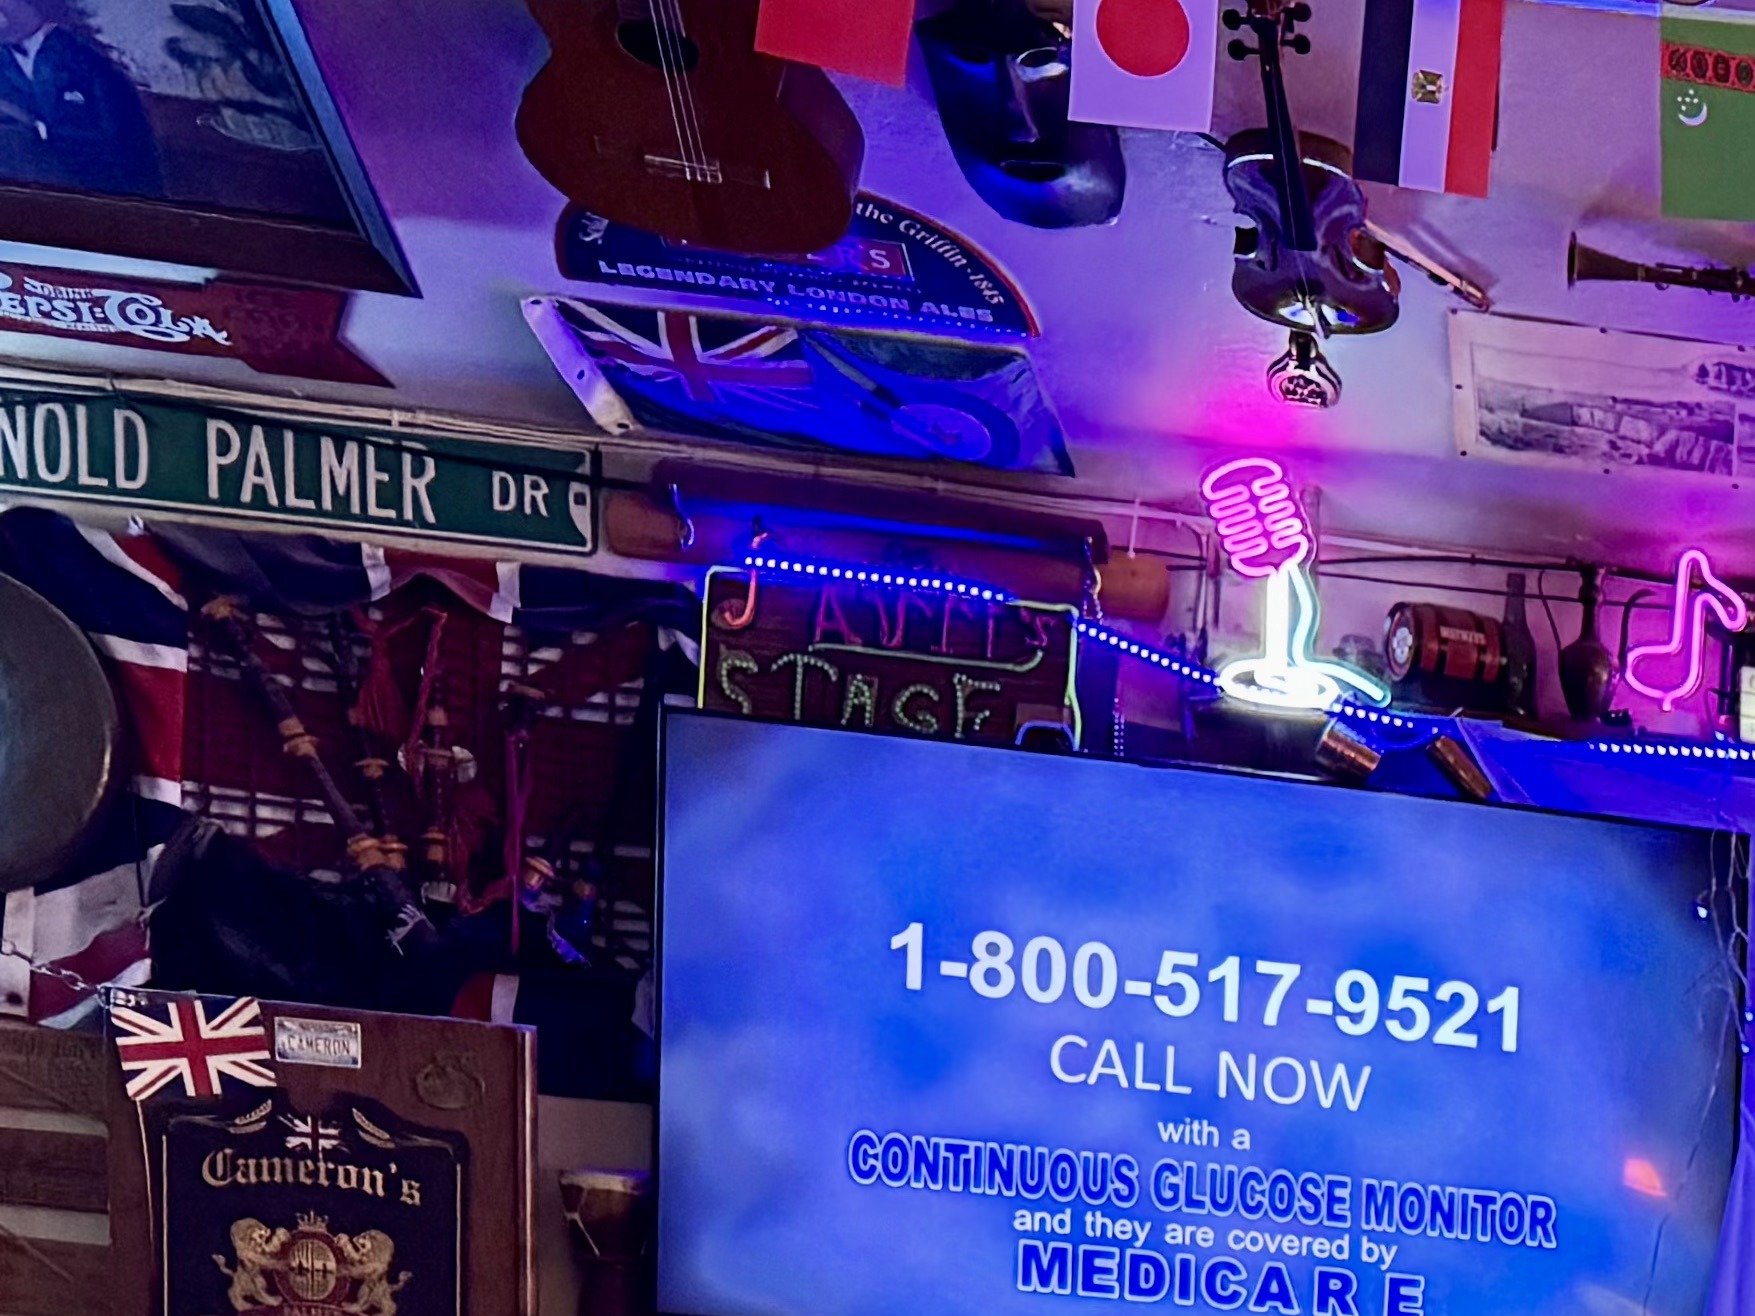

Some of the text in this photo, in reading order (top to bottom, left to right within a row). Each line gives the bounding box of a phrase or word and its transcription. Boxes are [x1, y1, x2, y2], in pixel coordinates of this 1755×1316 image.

[857, 202, 894, 226] the
[898, 217, 967, 270] Griffin
[599, 259, 776, 294] LEGENDARY
[787, 282, 910, 312] LONDON
[919, 300, 993, 323] ALES
[206, 418, 437, 525] PALMER
[492, 469, 550, 518] DR
[889, 921, 1520, 1054] 1-800-517-9521
[286, 1032, 351, 1057] CAMERON
[1049, 1033, 1372, 1111] CALL NOW
[1157, 1118, 1252, 1151] with a
[202, 1147, 421, 1206] Cameron's
[847, 1128, 1558, 1249] CONTINUOUS GLUCOSE MONITOR
[1013, 1206, 1398, 1271] and they are covered by
